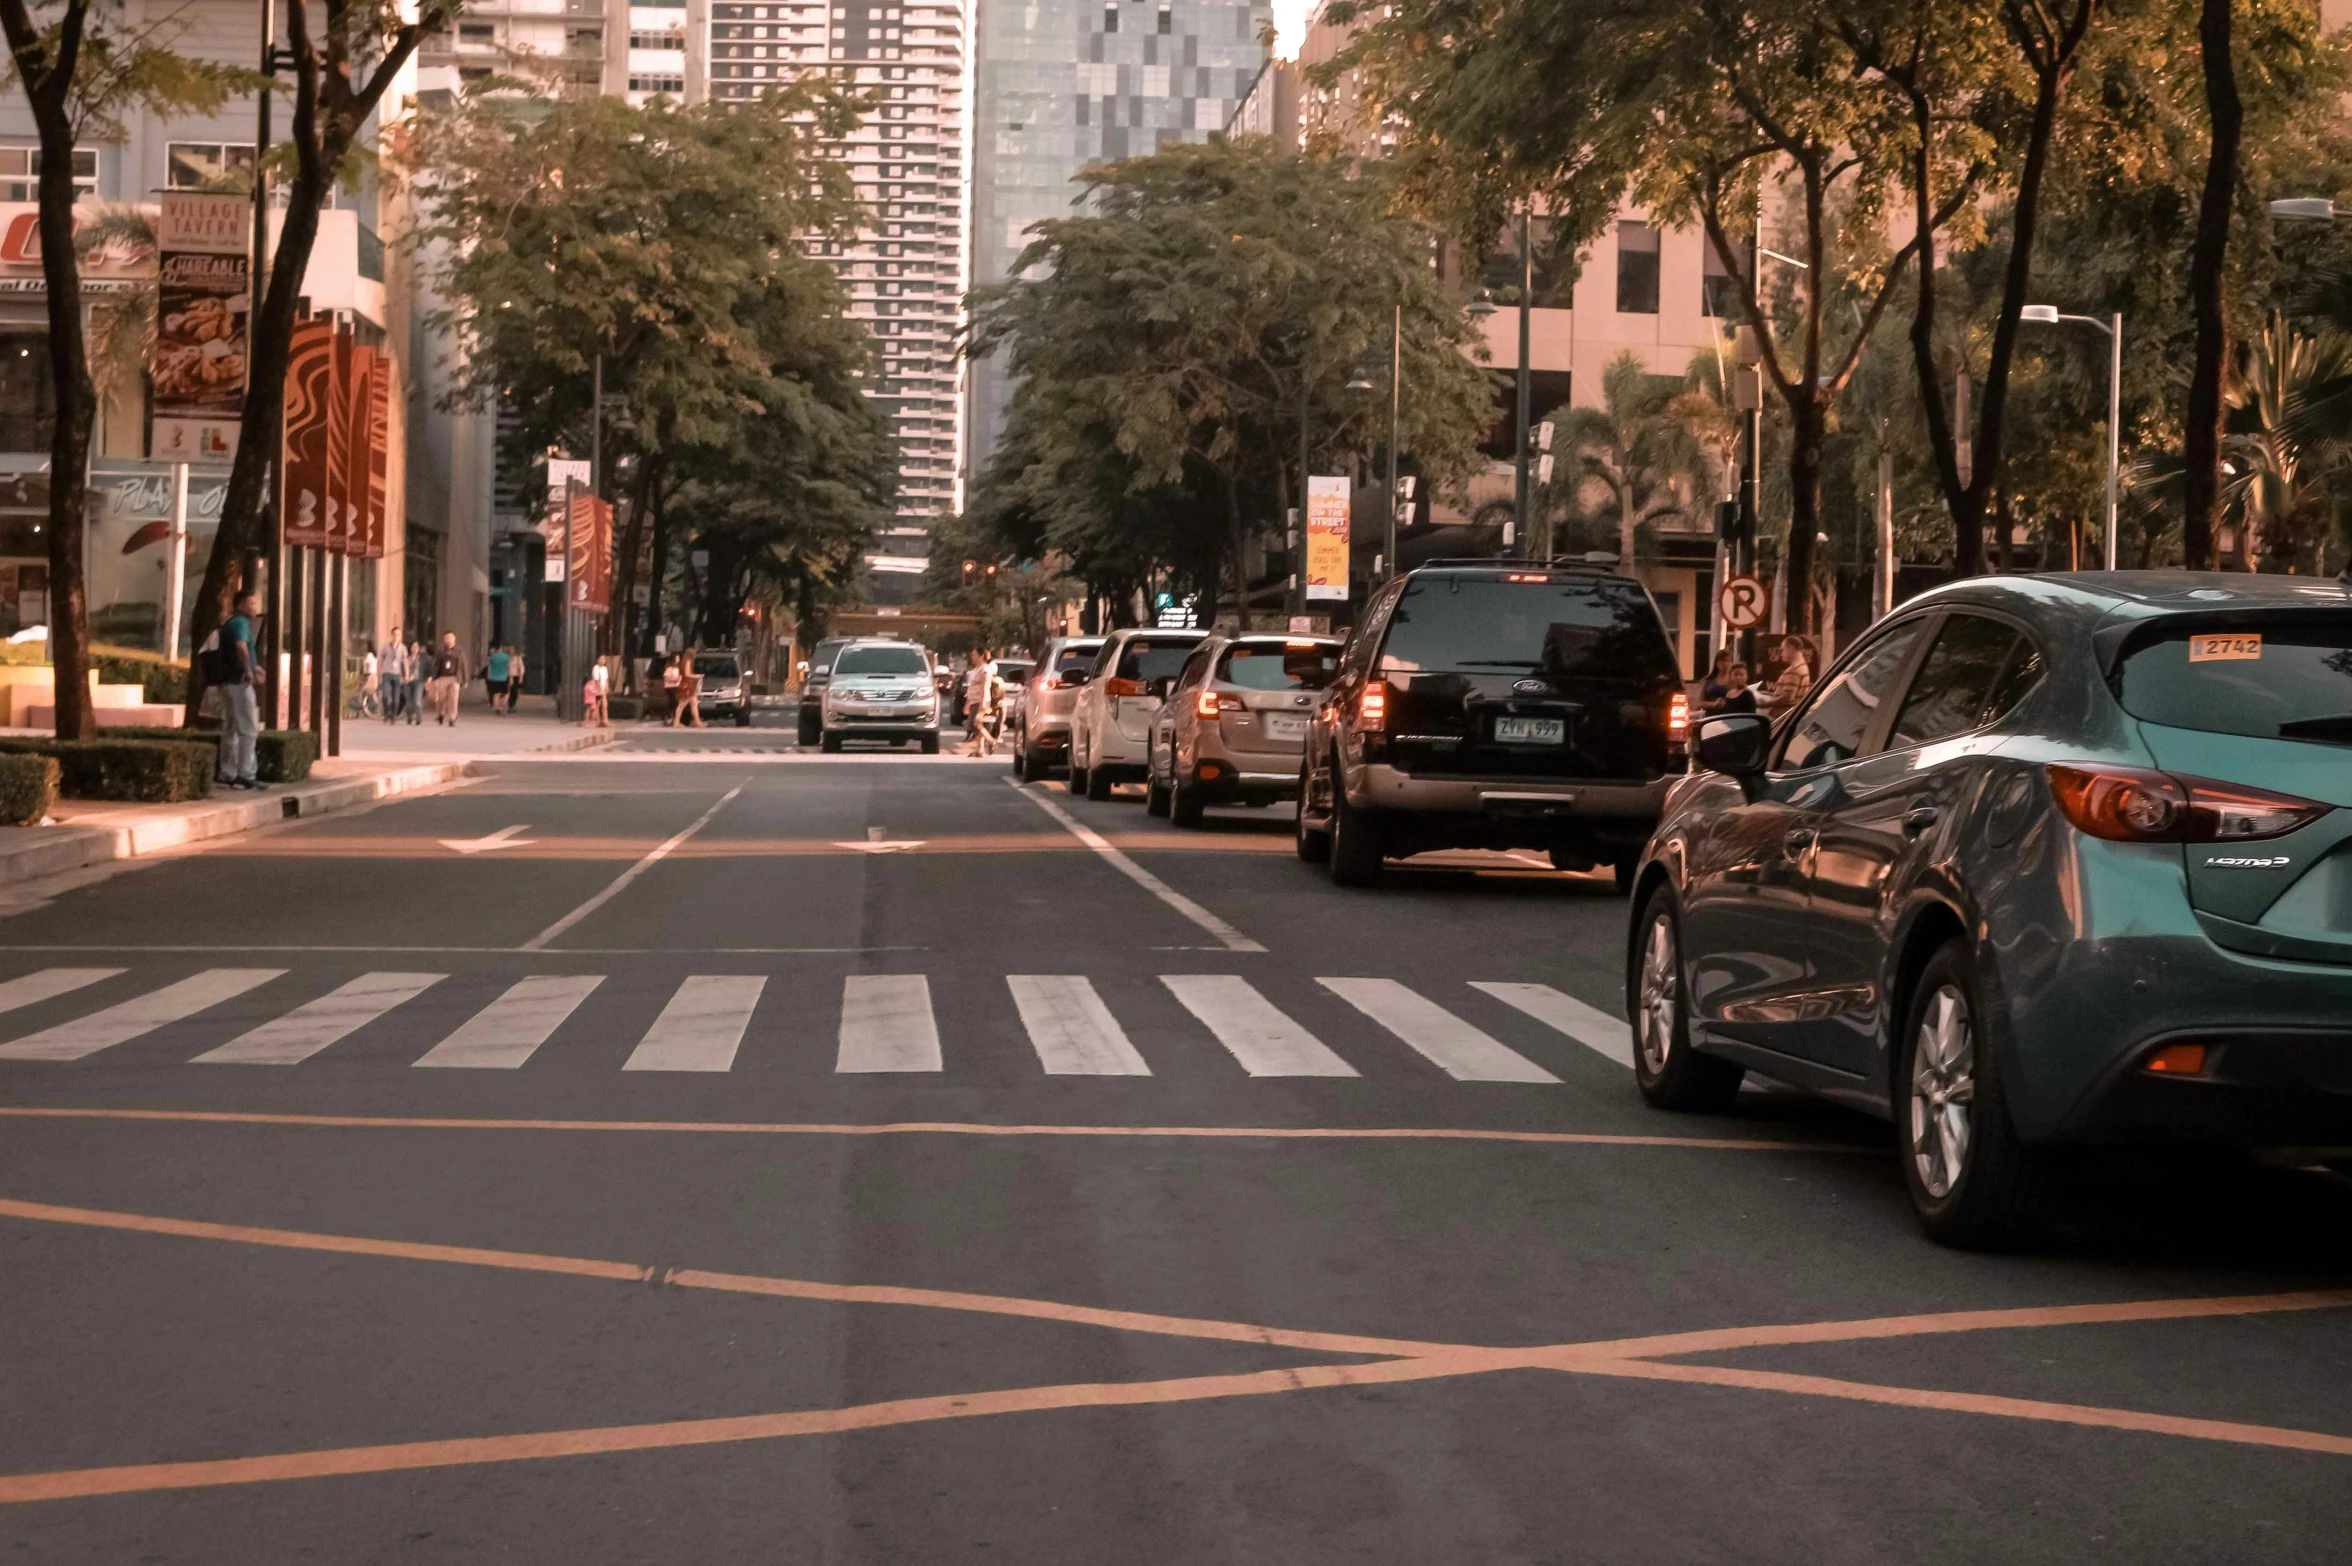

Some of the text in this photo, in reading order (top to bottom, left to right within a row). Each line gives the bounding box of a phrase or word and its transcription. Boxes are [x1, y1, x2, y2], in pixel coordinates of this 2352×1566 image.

[168, 201, 241, 220] VILLAGE
[173, 217, 238, 237] TAVERN
[1310, 518, 1346, 527] STREET
[2207, 640, 2260, 655] 2742
[1521, 682, 1540, 690] Ford
[1535, 721, 1559, 736] 999
